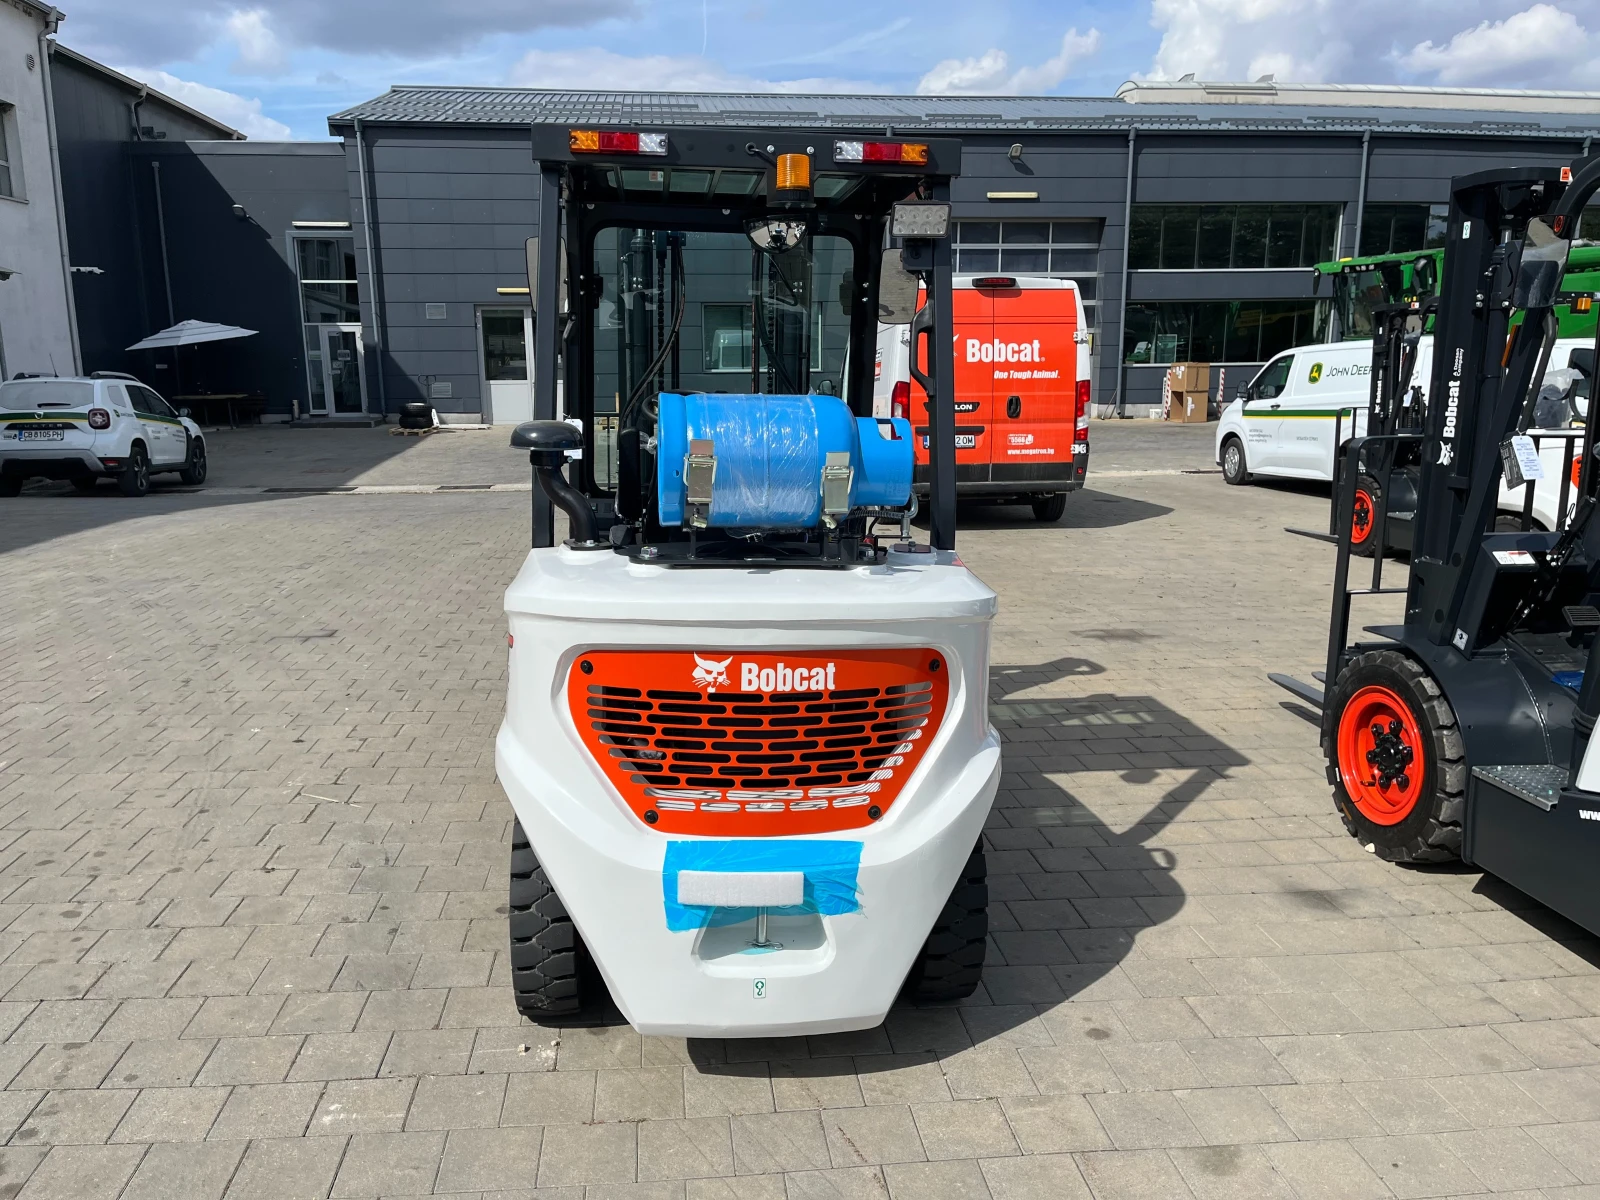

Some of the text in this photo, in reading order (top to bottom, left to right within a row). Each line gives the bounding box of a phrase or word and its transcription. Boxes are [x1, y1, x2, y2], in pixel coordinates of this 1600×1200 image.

[966, 338, 1040, 363] Bobcat
[1457, 348, 1465, 377] Company
[993, 370, 1008, 379] One
[1009, 370, 1032, 380] Tough
[1326, 365, 1350, 377] JOHN
[1350, 364, 1373, 376] DEER
[1442, 380, 1461, 438] Bobcat
[33, 430, 51, 438] 8105
[52, 430, 62, 438] PH
[740, 662, 836, 692] Bobcat
